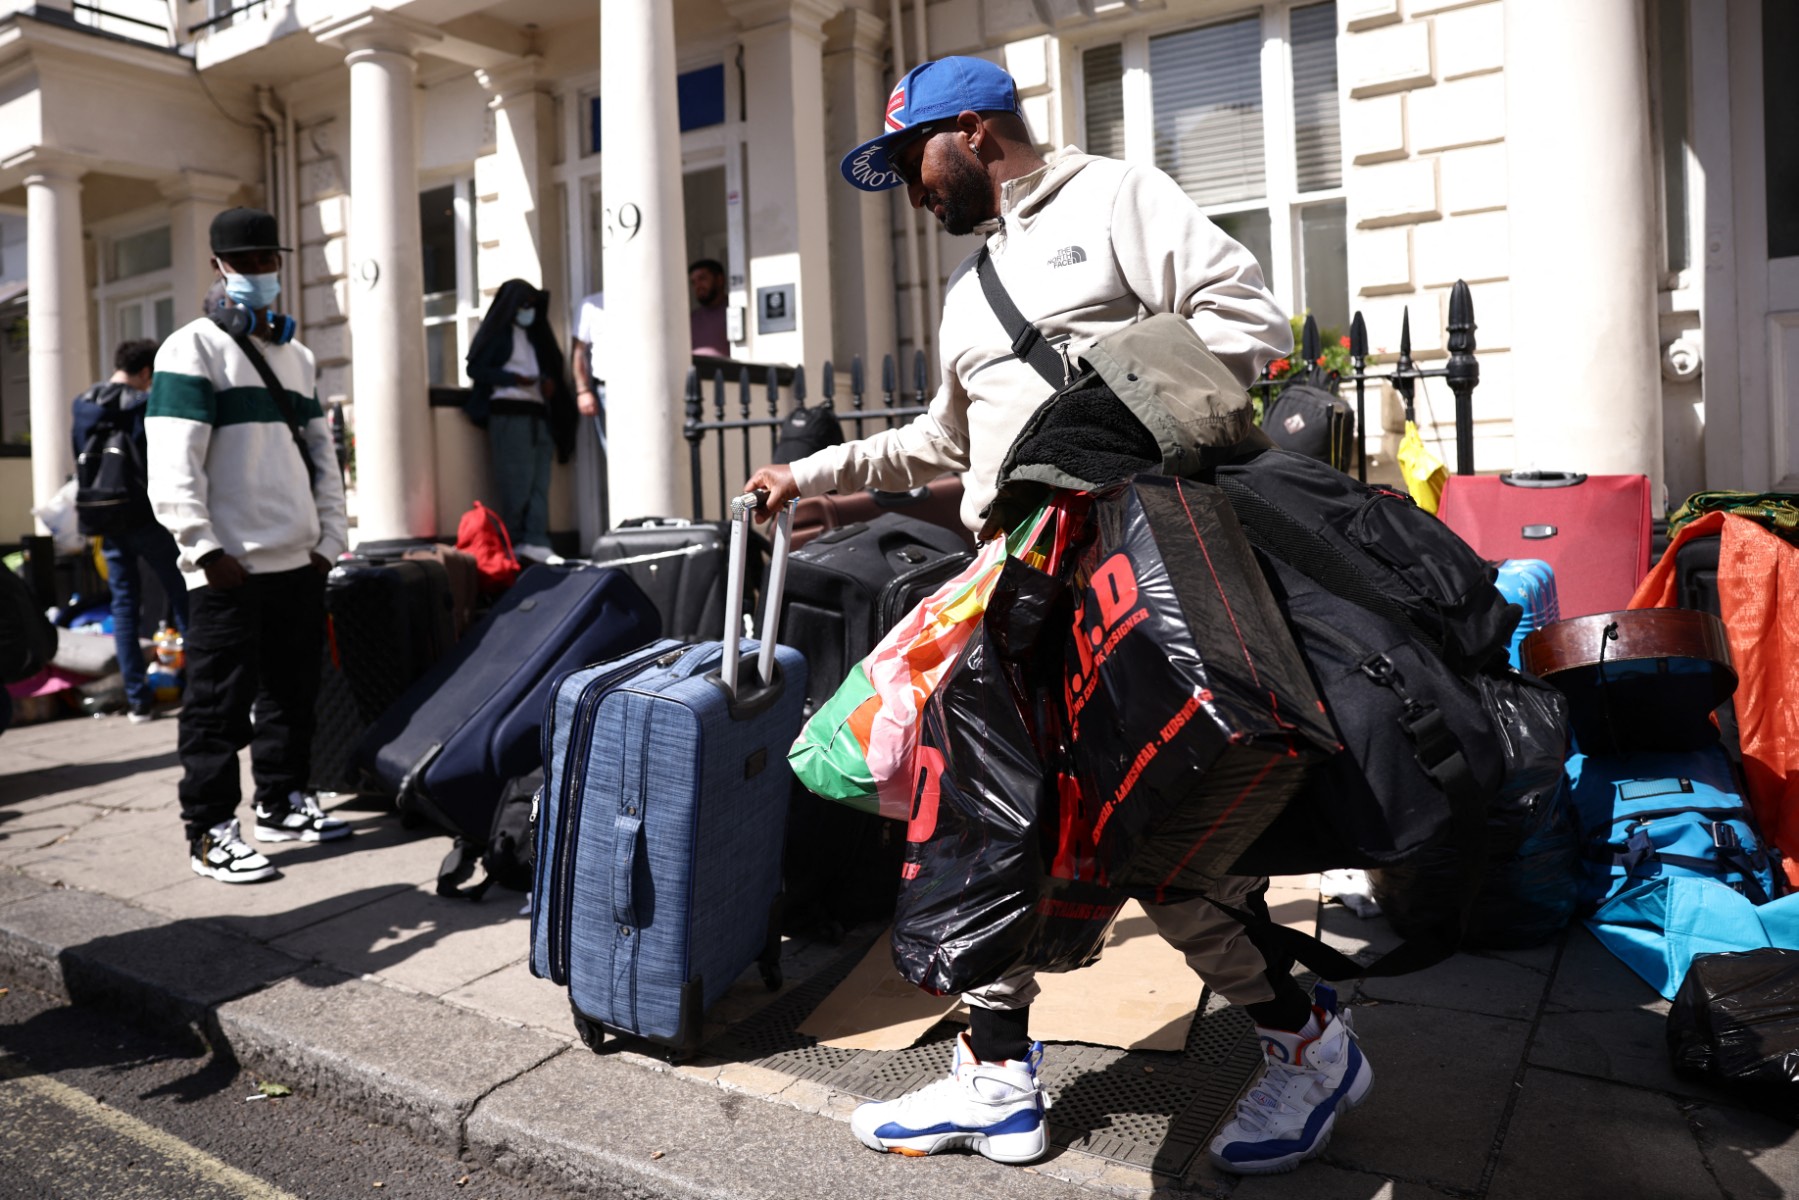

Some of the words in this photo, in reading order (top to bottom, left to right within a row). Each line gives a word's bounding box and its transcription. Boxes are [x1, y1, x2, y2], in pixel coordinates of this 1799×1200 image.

[852, 145, 898, 187] LONDON
[1057, 246, 1070, 256] THE
[1047, 252, 1071, 266] NORTH
[1053, 259, 1072, 269] FACE
[1105, 608, 1150, 657] DESIGNER
